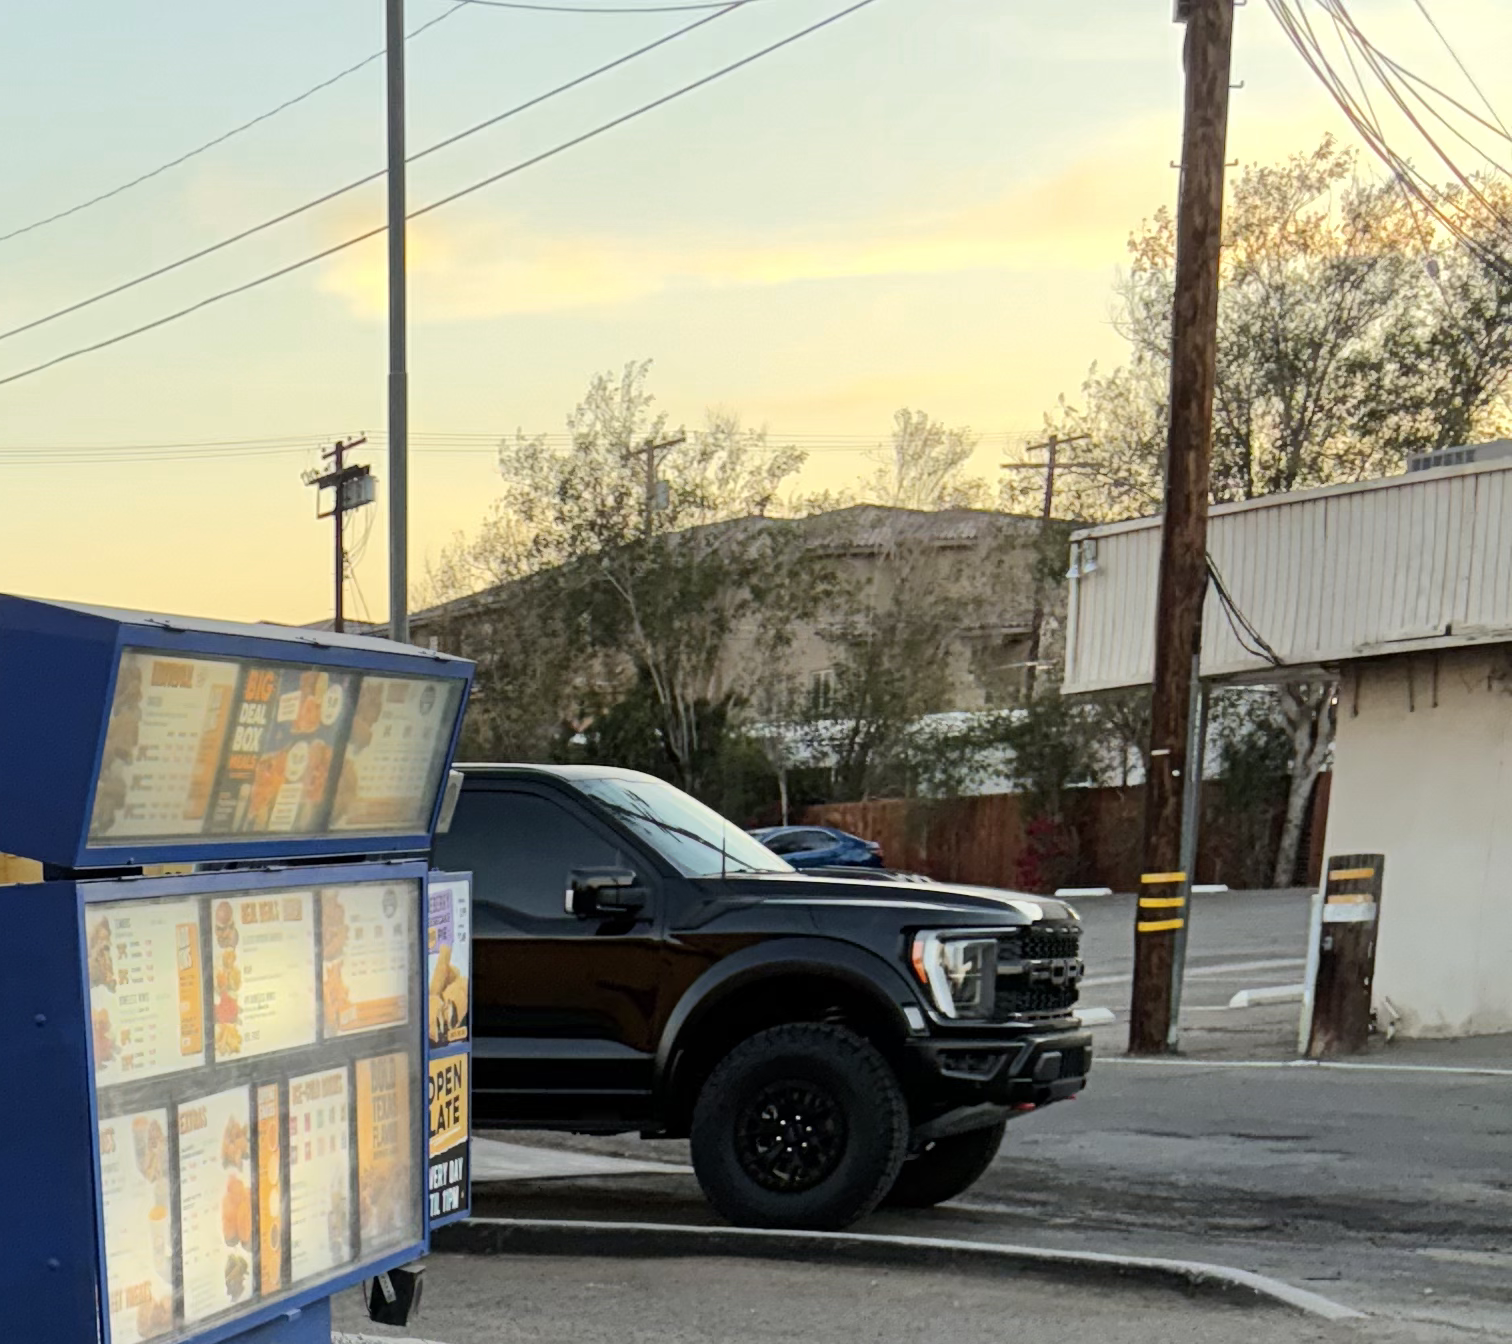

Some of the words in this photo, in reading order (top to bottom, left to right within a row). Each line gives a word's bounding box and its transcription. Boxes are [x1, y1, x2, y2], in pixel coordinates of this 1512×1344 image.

[245, 670, 275, 702] BIG
[239, 702, 267, 725] DEAL
[232, 726, 264, 752] BOX
[429, 1060, 462, 1101] OPEN
[429, 1095, 460, 1136] LATE
[429, 1162, 448, 1190] VERY
[449, 1157, 464, 1184] DAY
